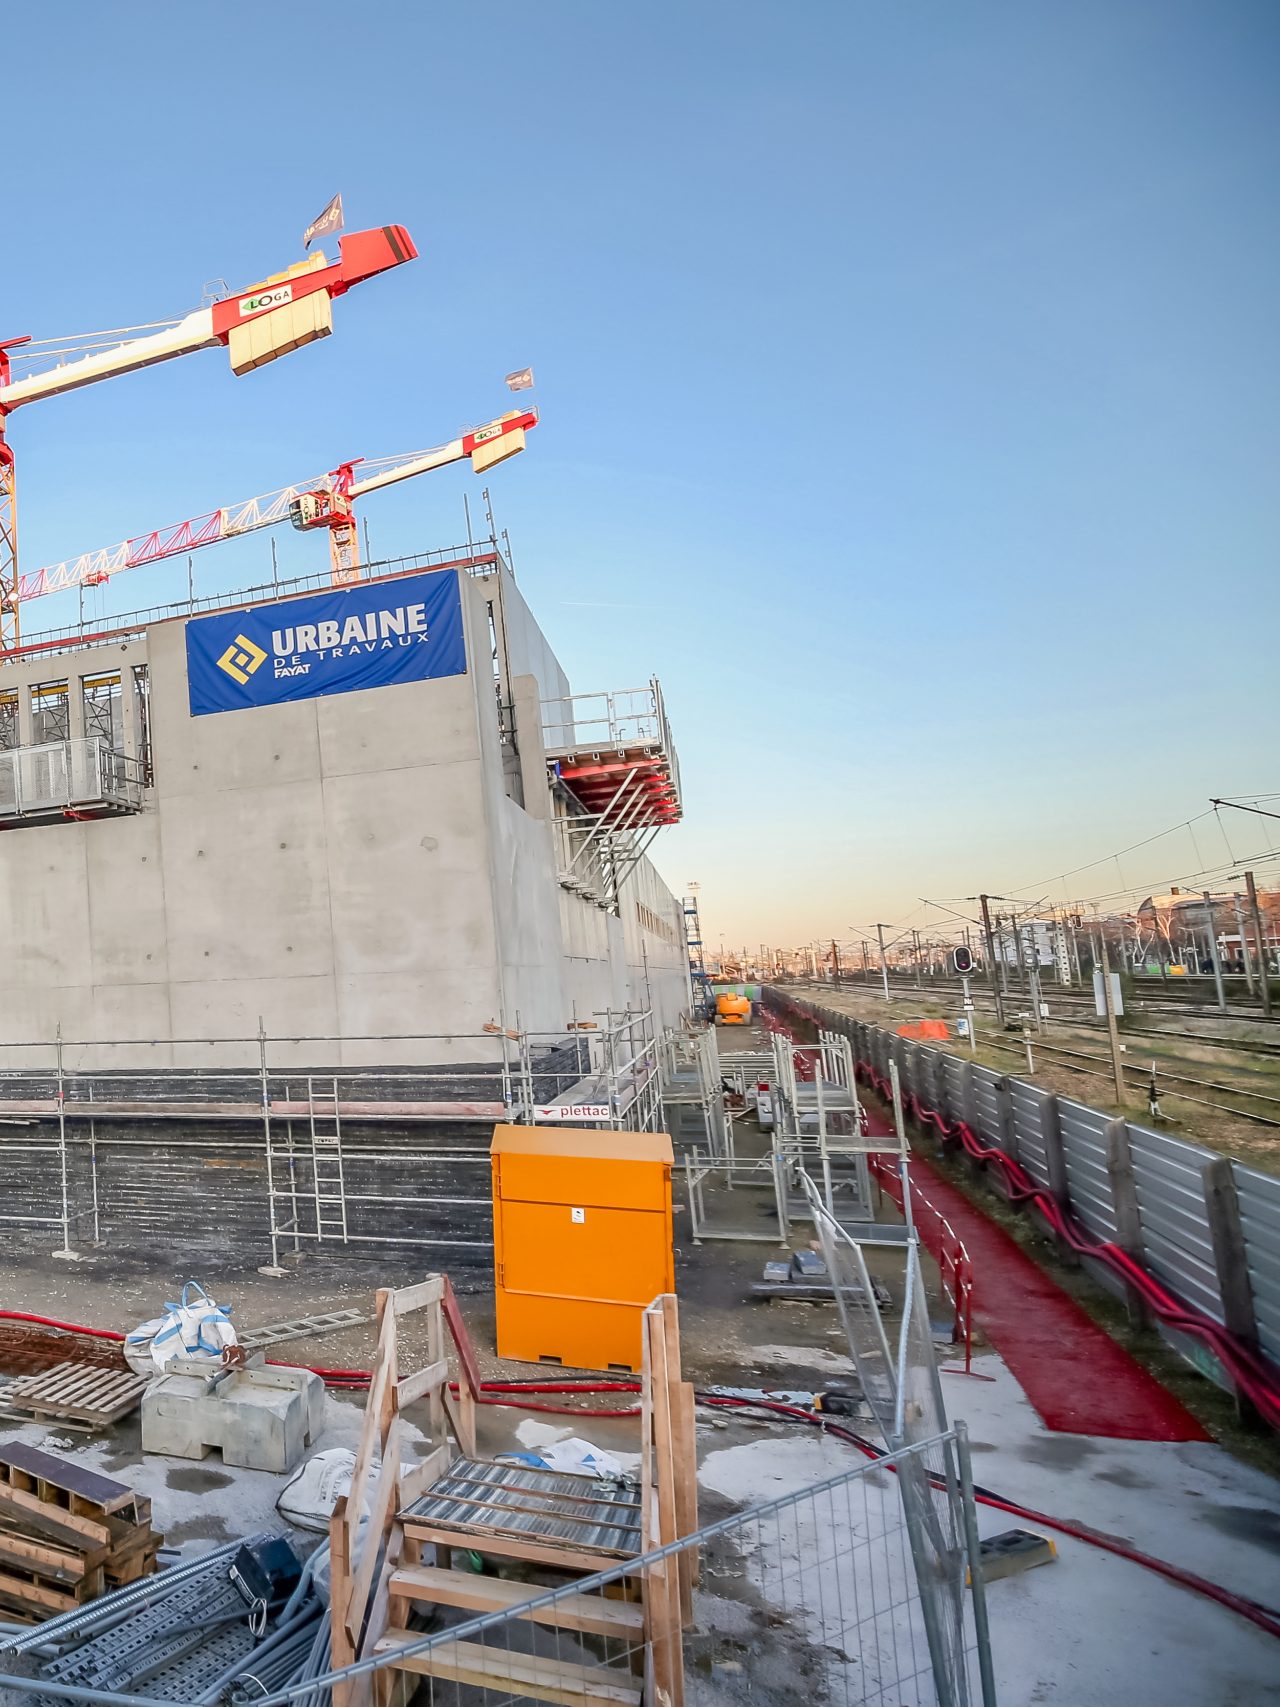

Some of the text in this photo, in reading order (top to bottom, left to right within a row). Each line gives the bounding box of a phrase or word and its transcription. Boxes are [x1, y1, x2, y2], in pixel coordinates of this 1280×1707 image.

[250, 289, 290, 310] LOGA
[272, 603, 428, 657] URBAINE
[274, 631, 430, 668] DE TRAVAUX
[274, 663, 312, 679] FAYAT
[561, 1105, 609, 1119] plettac
